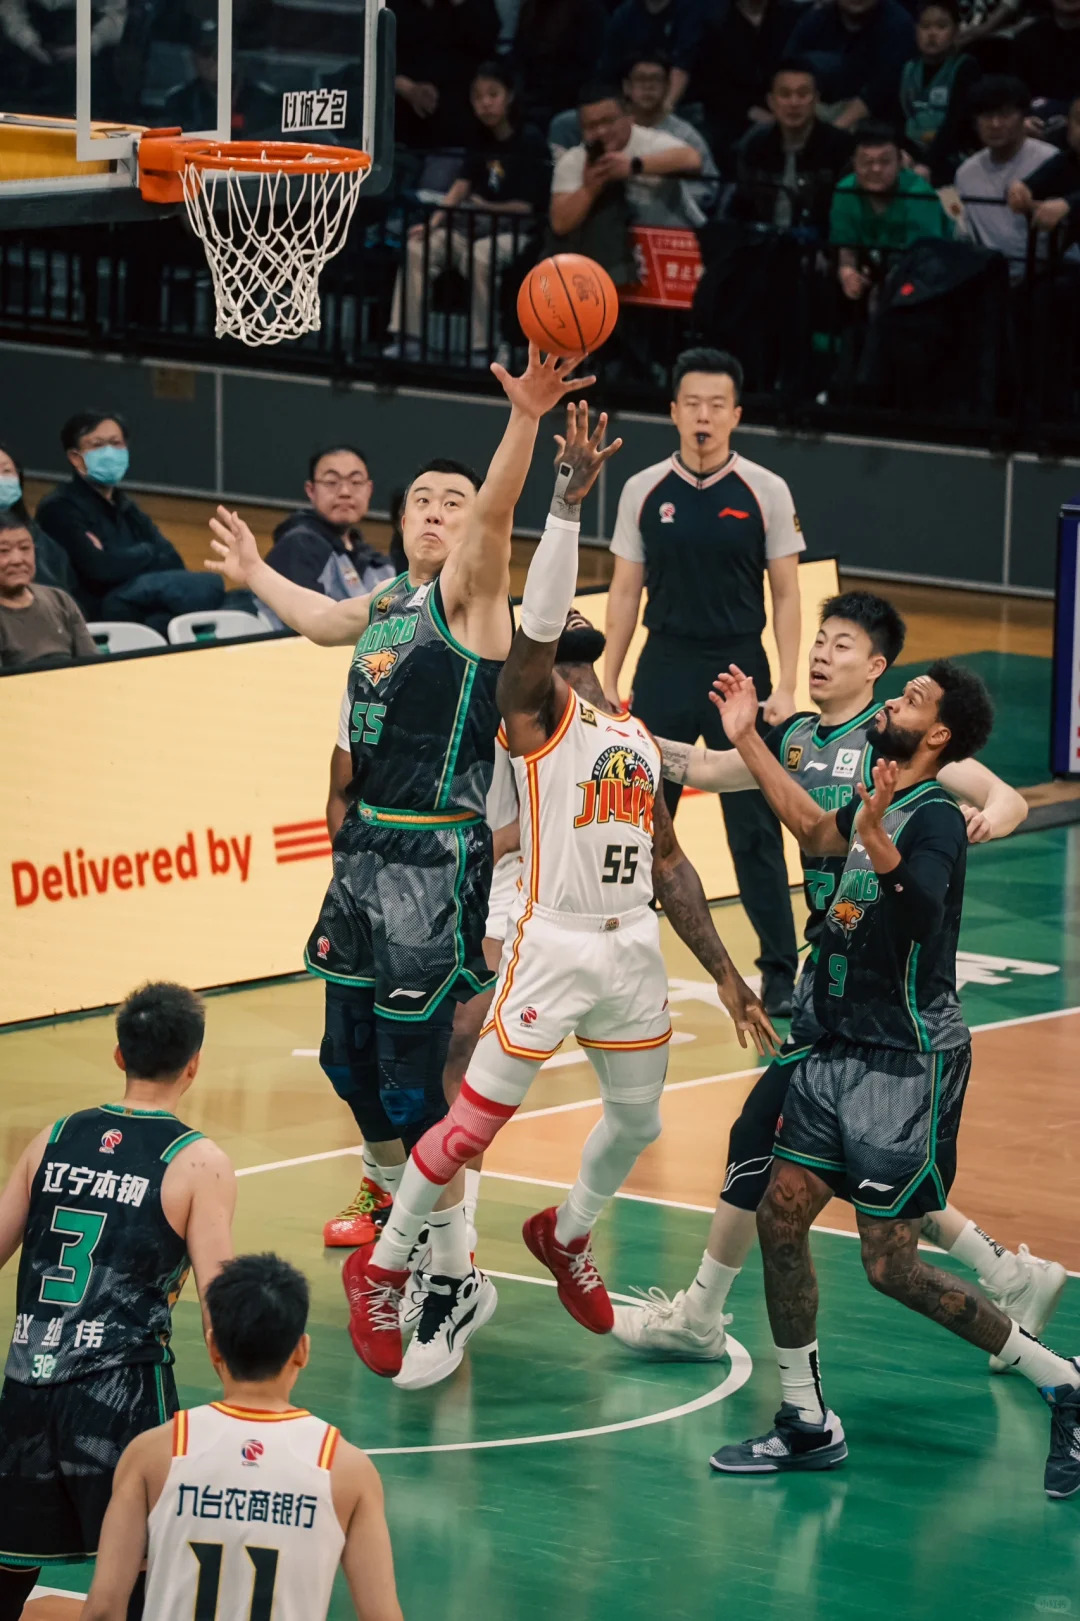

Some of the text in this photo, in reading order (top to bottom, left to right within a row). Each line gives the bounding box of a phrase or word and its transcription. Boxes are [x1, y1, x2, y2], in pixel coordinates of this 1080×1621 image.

[283, 91, 346, 130] 以城之名
[351, 701, 388, 745] 55
[11, 828, 252, 907] Delivered by
[602, 845, 638, 884] 55
[829, 953, 848, 998] 9
[42, 1162, 150, 1208] 辽宁本钢
[38, 1205, 108, 1306] 3
[177, 1483, 318, 1529] 九台农商银行
[187, 1541, 279, 1621] 11
